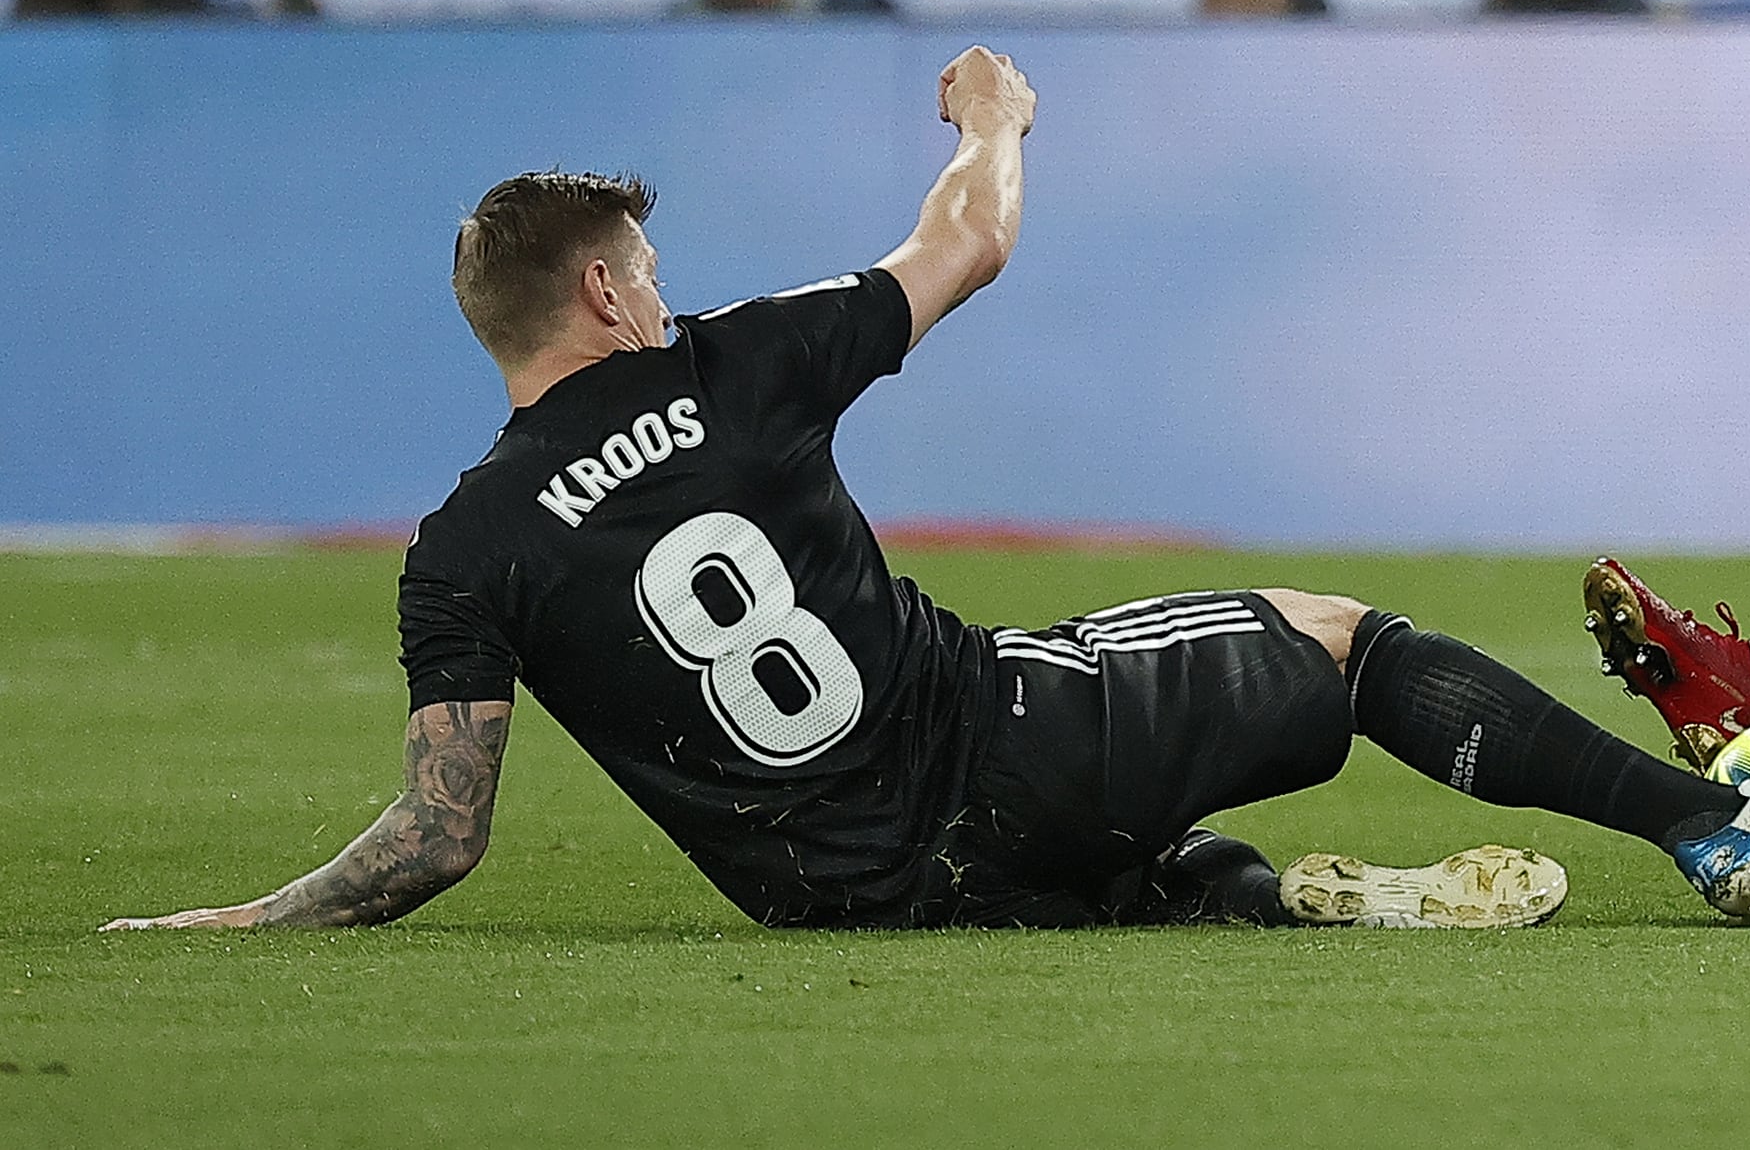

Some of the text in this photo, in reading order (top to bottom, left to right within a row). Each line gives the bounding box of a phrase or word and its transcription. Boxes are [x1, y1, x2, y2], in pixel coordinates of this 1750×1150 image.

[536, 396, 706, 529] KROOS
[633, 510, 865, 768] 8
[1449, 739, 1470, 788] REAL
